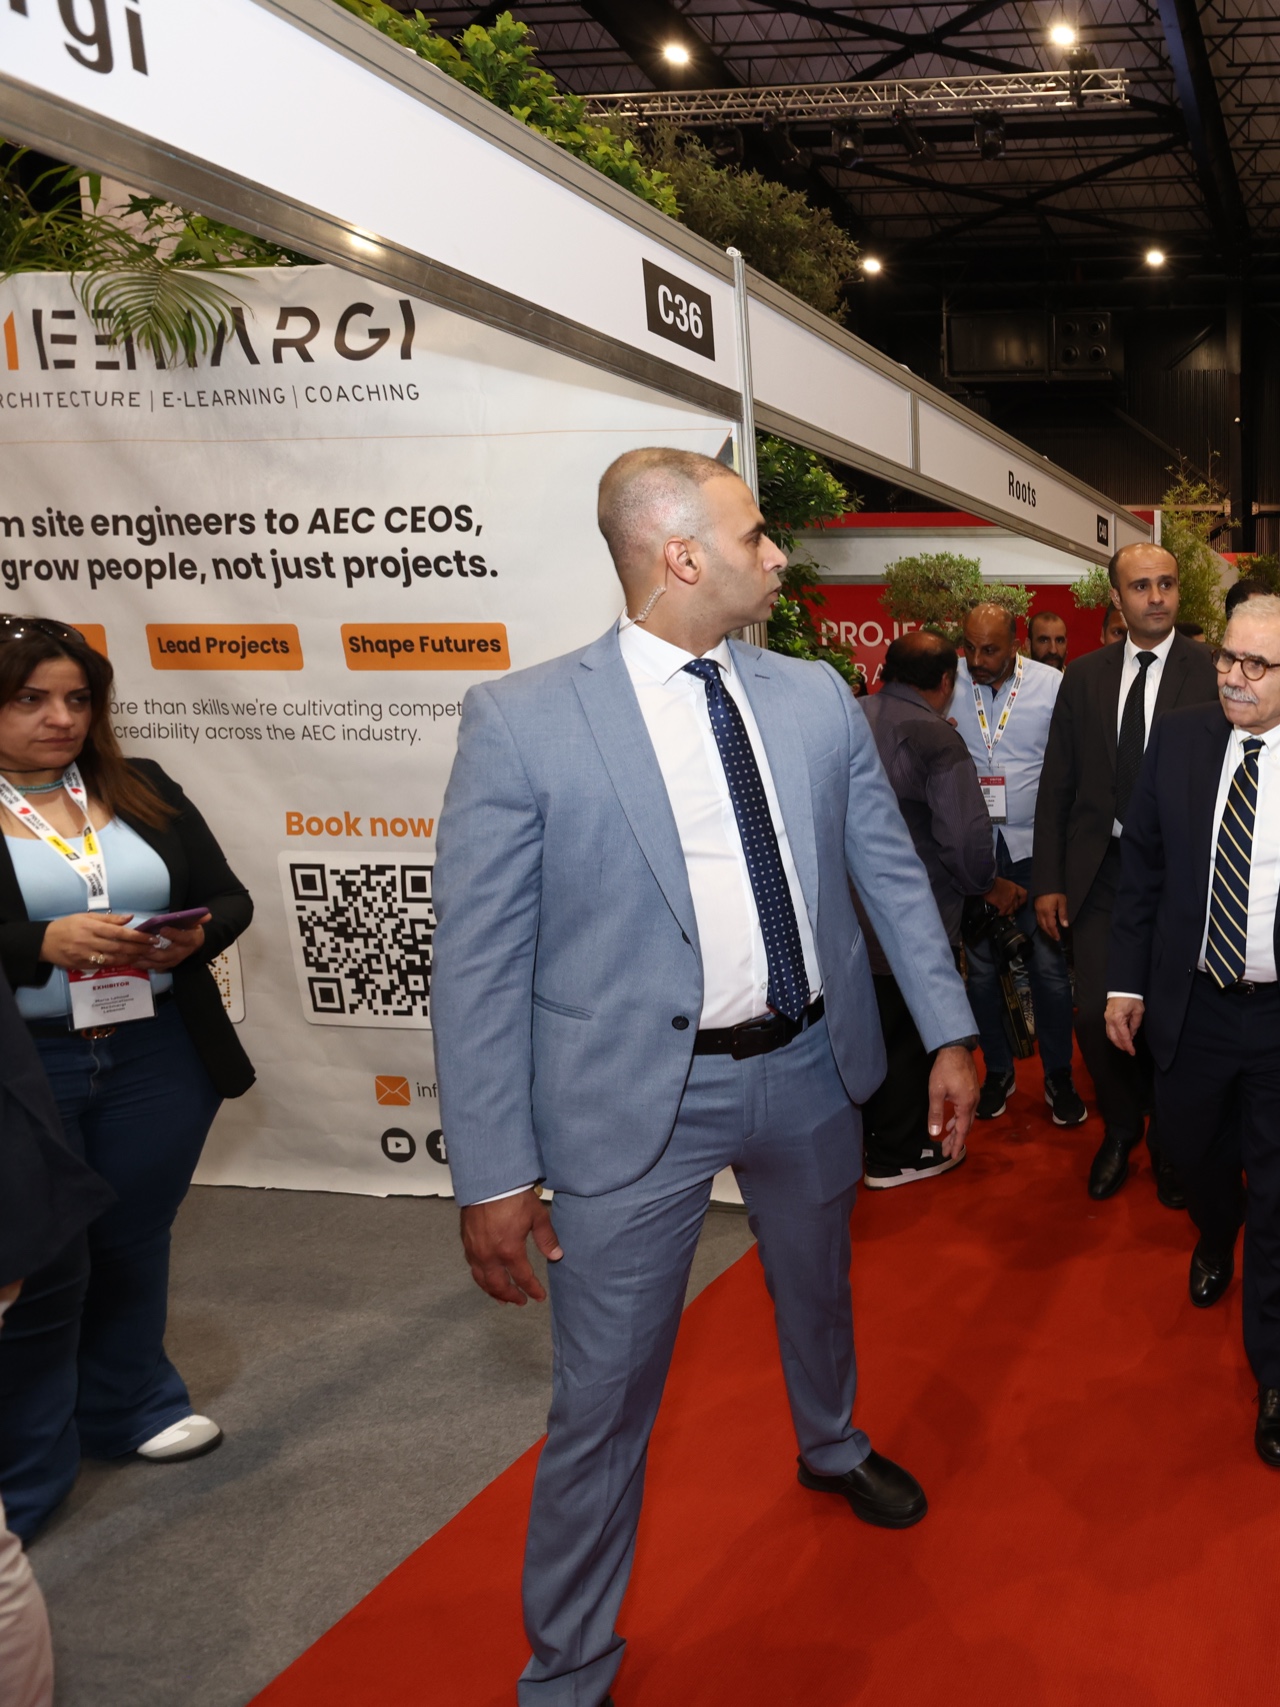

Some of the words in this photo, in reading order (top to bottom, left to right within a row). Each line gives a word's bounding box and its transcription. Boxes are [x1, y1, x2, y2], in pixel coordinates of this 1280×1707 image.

[9, 0, 149, 76] gi
[657, 284, 704, 339] C36
[162, 387, 286, 408] E-LEARNING
[304, 383, 420, 404] COACHING
[1008, 470, 1037, 508] Roots
[32, 507, 84, 538] site
[90, 505, 256, 547] engineers
[264, 508, 299, 535] to
[306, 506, 376, 535] AEC
[383, 504, 483, 537] CEOS,
[1, 558, 80, 591] grow
[87, 551, 207, 590] people,
[211, 551, 266, 580] not
[271, 548, 336, 589] just
[342, 546, 499, 589] projects.
[157, 636, 201, 654] Lead
[205, 635, 290, 660] Projects
[348, 635, 415, 659] Shape
[419, 635, 502, 653] Futures
[144, 698, 187, 715] than
[192, 698, 230, 716] skills
[230, 698, 277, 717] we're
[283, 698, 383, 721] cultivating
[388, 700, 463, 722] compet
[113, 722, 200, 744] credibility
[204, 724, 262, 741] across
[266, 724, 296, 741] the
[301, 724, 336, 741] AEC
[342, 724, 422, 746] industry.
[285, 810, 362, 837] Book
[369, 817, 435, 838] now
[92, 981, 130, 992] EXHIBITOR
